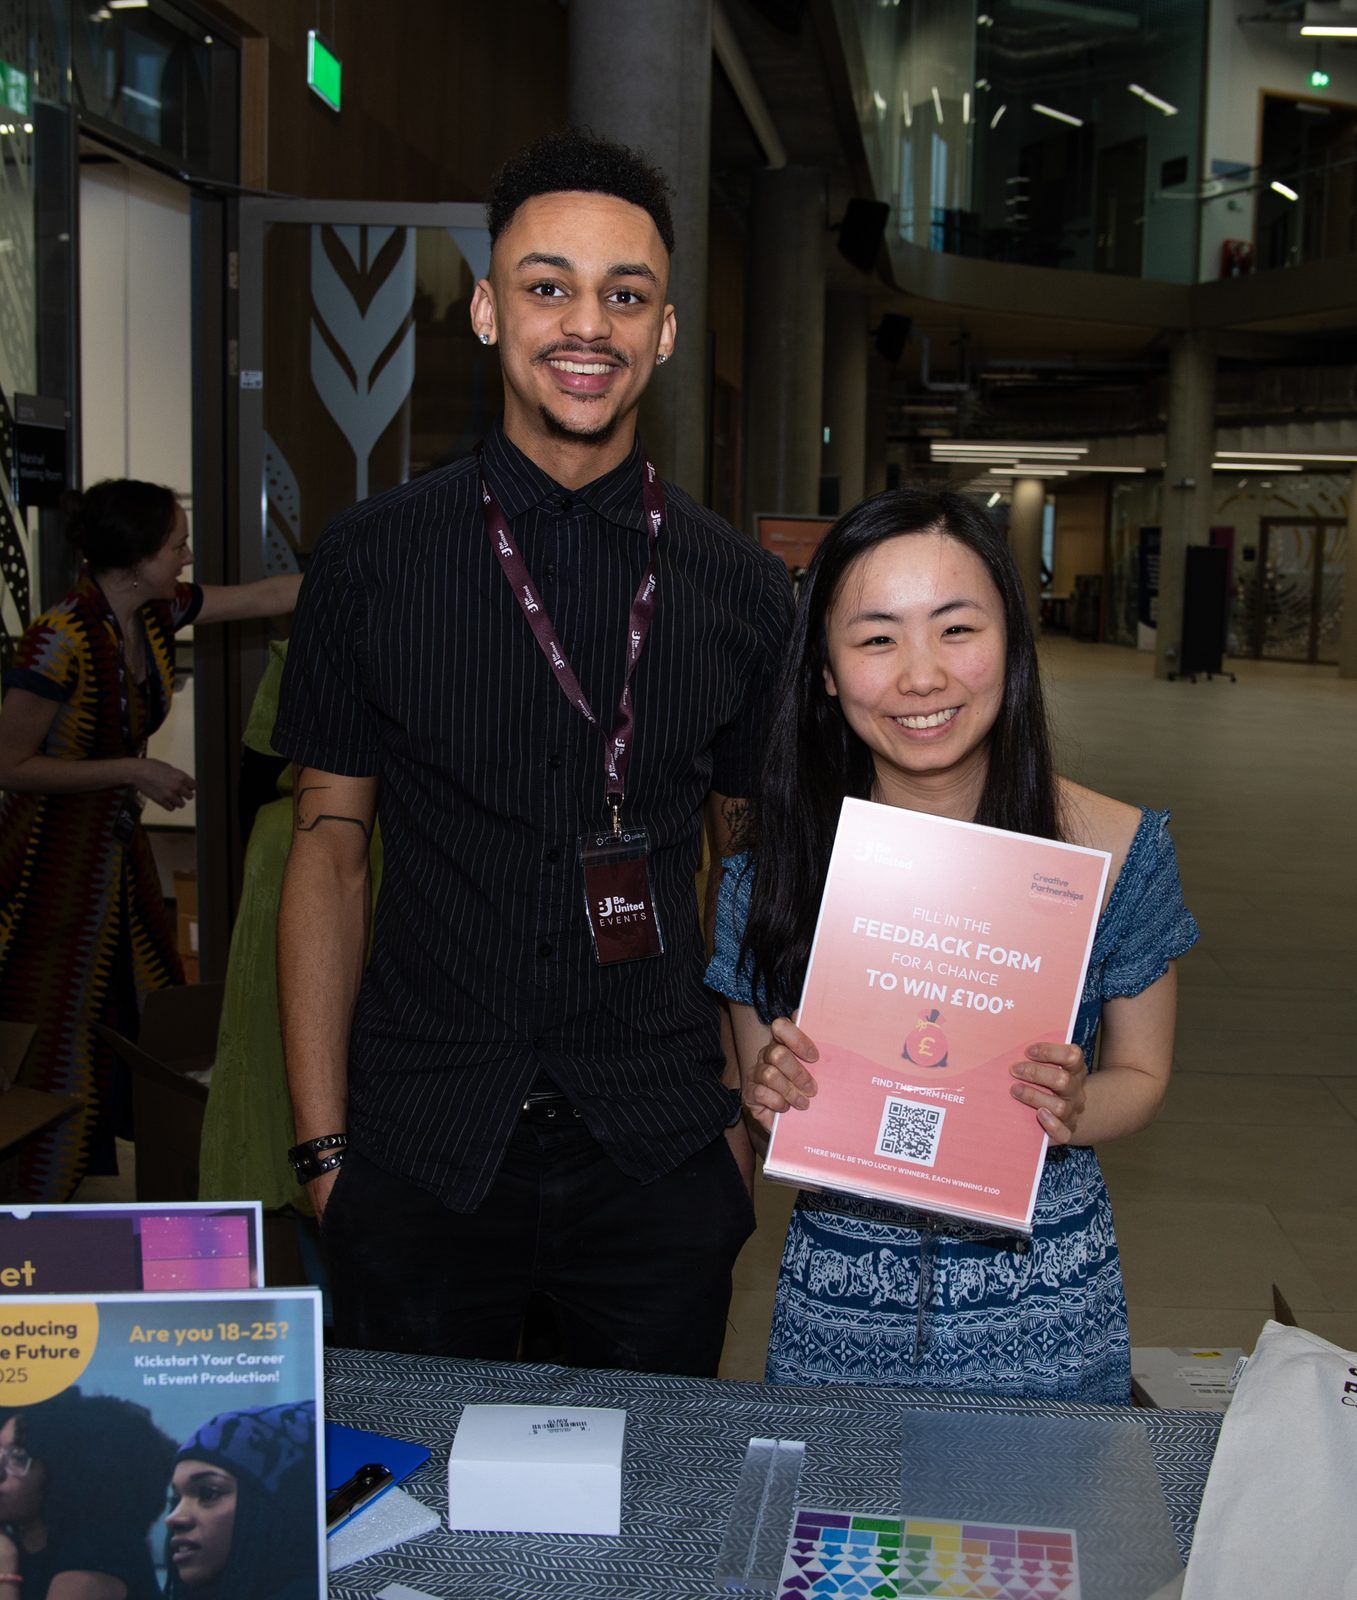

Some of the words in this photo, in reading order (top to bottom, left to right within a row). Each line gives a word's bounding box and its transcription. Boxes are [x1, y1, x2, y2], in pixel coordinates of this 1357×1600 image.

[1032, 872, 1069, 887] Creative
[612, 896, 625, 905] Be
[1031, 882, 1084, 901] Partnerships
[614, 901, 645, 913] United
[599, 912, 647, 927] EVENTS
[912, 907, 942, 925] FILL
[944, 914, 960, 927] IN
[963, 917, 992, 935] THE
[852, 916, 974, 959] FEEDBACK
[975, 943, 1042, 973] FORM
[891, 952, 921, 969] FOR
[923, 959, 934, 973] A
[937, 962, 999, 986] CHANCE
[866, 968, 897, 991] TO
[902, 976, 948, 1003] WIN
[871, 1076, 893, 1088] FIND
[894, 1081, 913, 1092] THE
[913, 1086, 940, 1099] FORM
[941, 1092, 965, 1104] HERE
[829, 1152, 846, 1162] WILL
[847, 1155, 856, 1164] BE
[856, 1157, 874, 1168] TWO
[874, 1161, 897, 1172] LUCKY
[897, 1167, 930, 1181] WINNERS,
[931, 1174, 951, 1185] EACH
[951, 1179, 983, 1192] WINNING
[983, 1185, 1001, 1196] £100
[129, 1325, 170, 1343] Are
[174, 1328, 214, 1347] you
[217, 1321, 289, 1341] 18-25?
[15, 1344, 80, 1360] Future
[134, 1354, 199, 1368] Kickstart
[201, 1353, 234, 1366] Your
[236, 1352, 285, 1365] Career
[143, 1374, 156, 1386] in
[158, 1373, 199, 1385] Event
[200, 1370, 280, 1384] Production!
